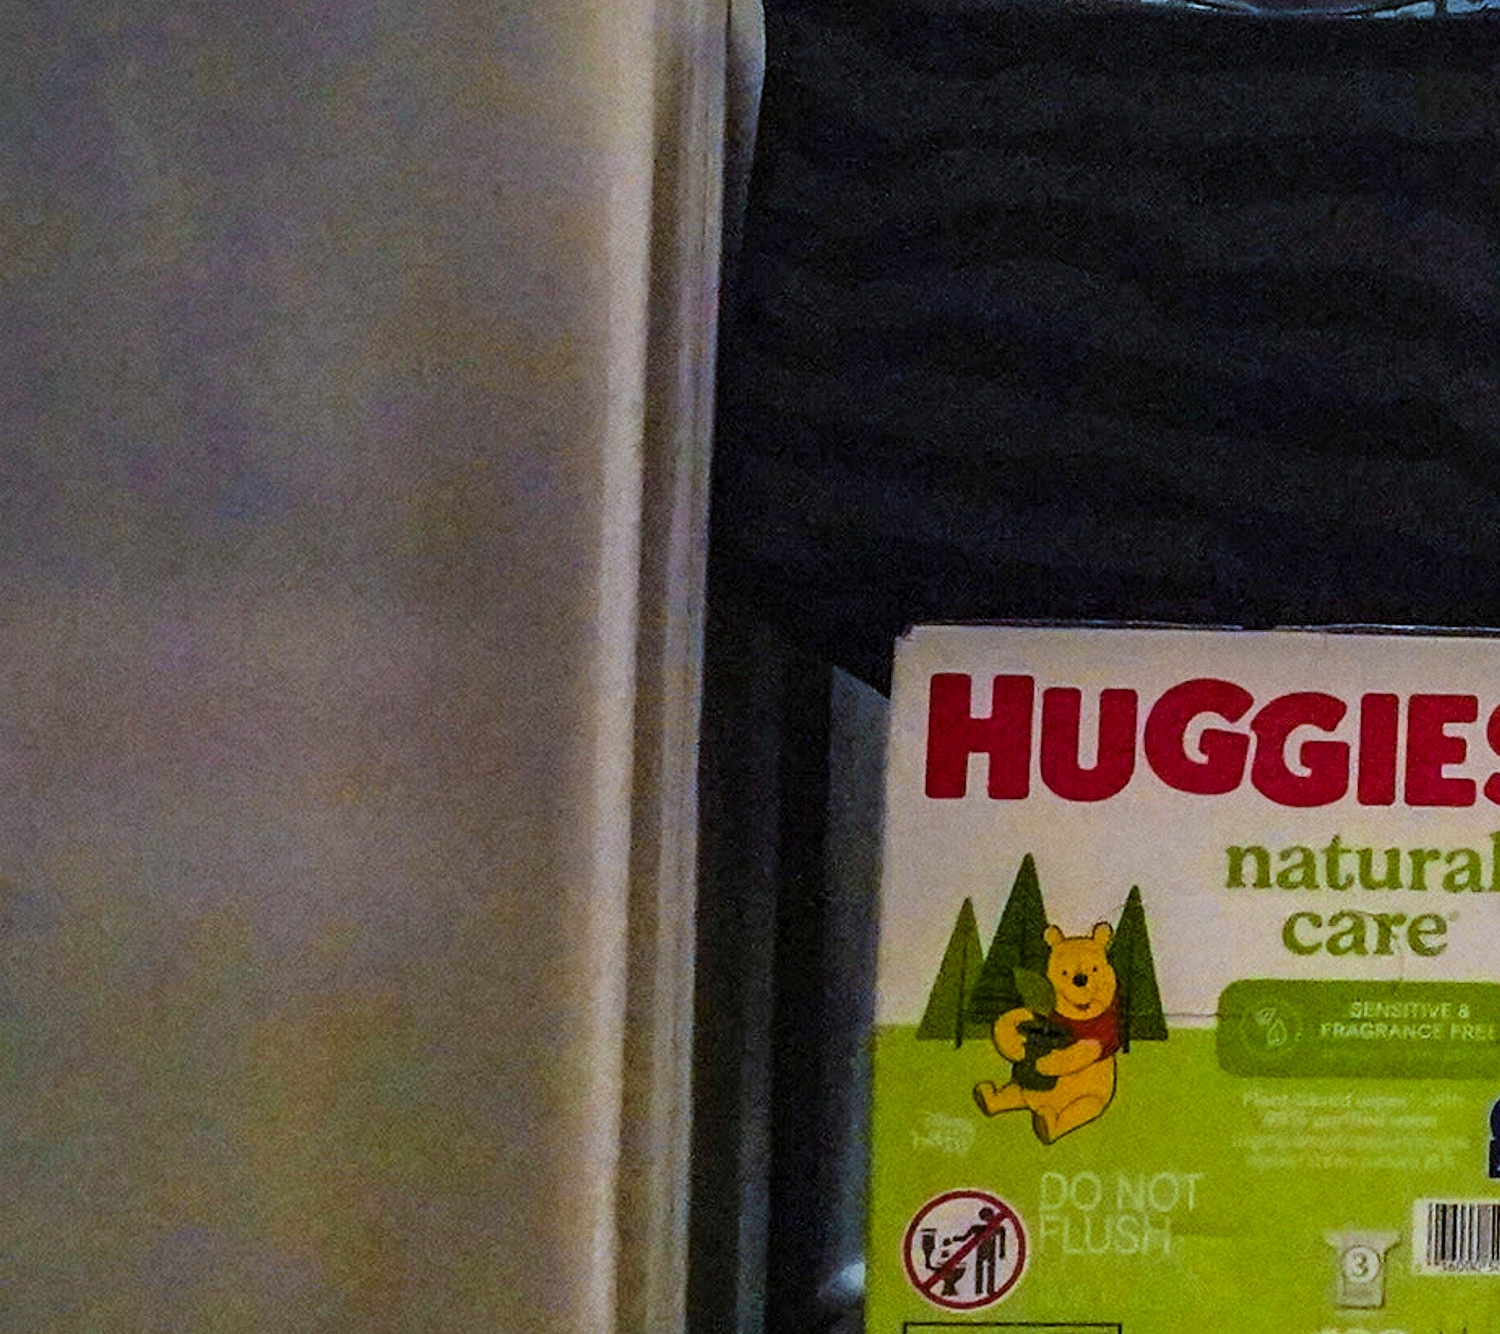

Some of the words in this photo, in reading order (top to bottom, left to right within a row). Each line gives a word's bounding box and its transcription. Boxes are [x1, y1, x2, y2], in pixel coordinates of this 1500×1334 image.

[1282, 910, 1450, 958] care
[1351, 1002, 1450, 1018] SENSITIVE
[1320, 1023, 1441, 1040] FRAGRANCE
[1451, 1024, 1496, 1040] FREE
[1039, 1171, 1102, 1211] DO
[1117, 1171, 1204, 1212] NOT
[1039, 1214, 1171, 1255] FLUSH
